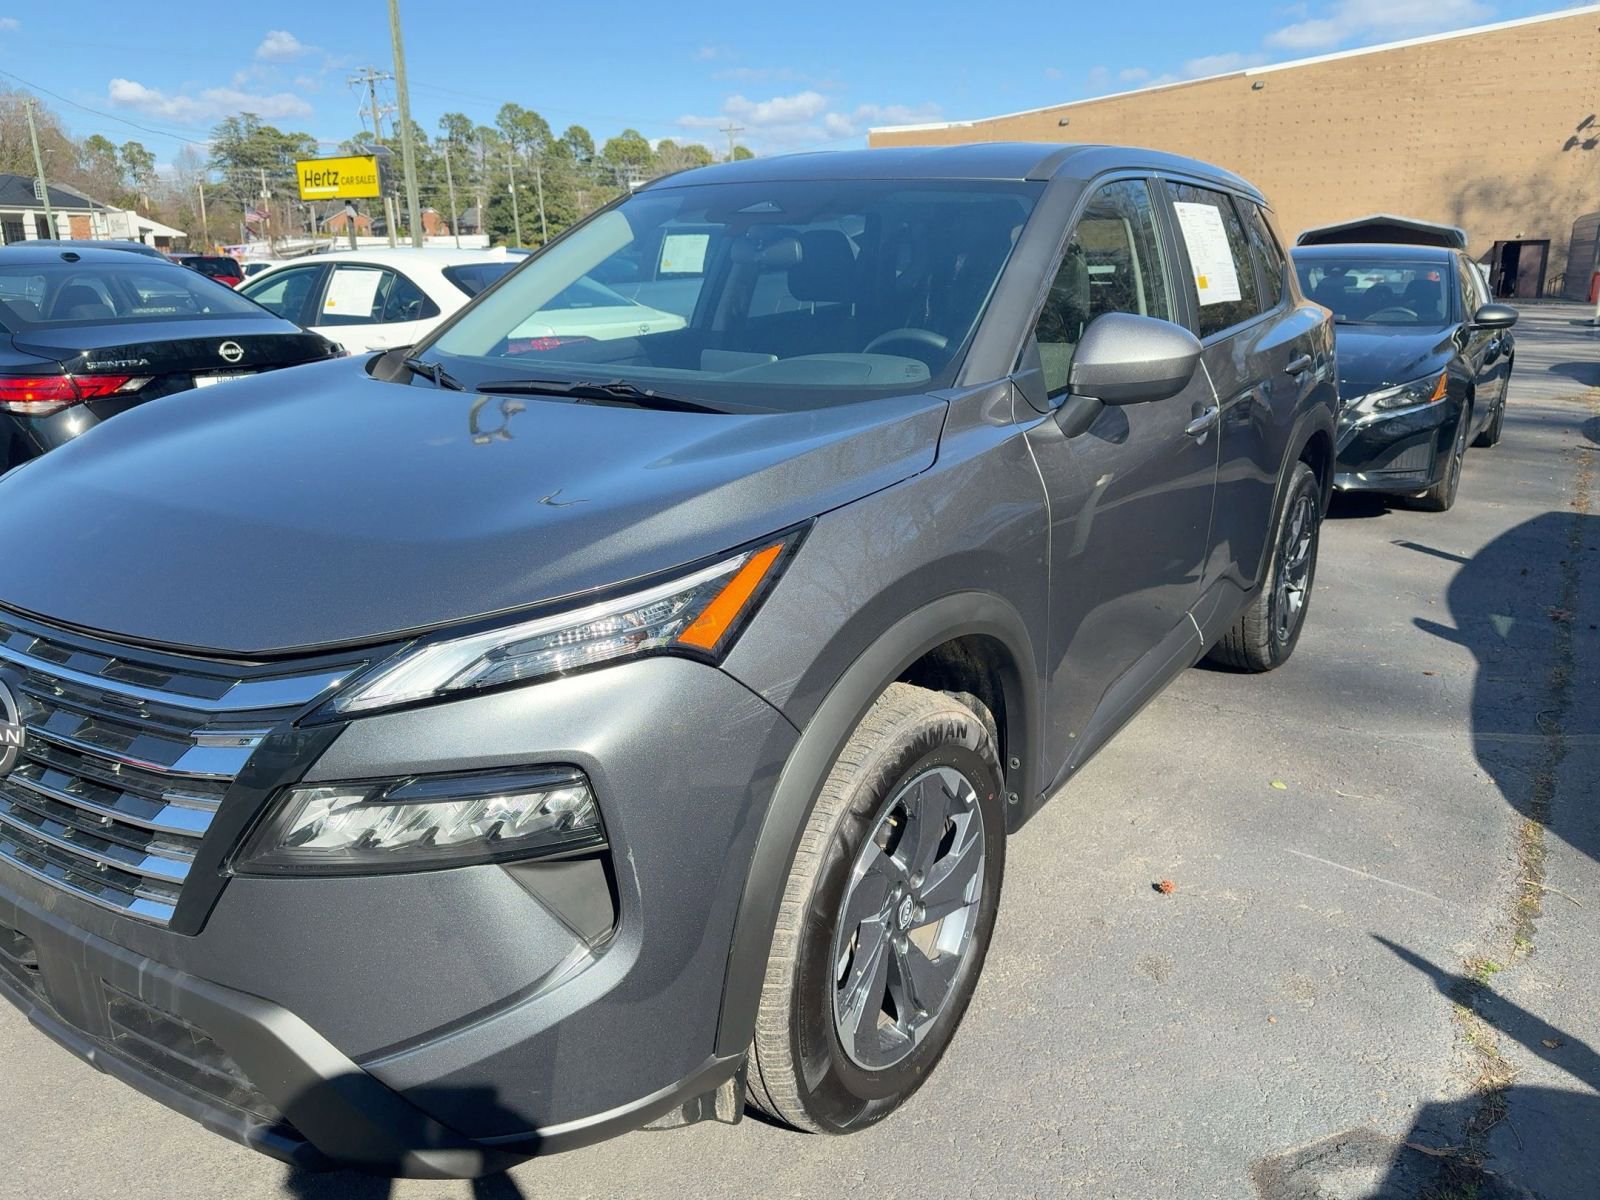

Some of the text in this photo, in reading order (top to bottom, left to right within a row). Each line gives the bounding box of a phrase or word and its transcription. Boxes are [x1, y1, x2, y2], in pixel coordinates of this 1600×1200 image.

[304, 169, 376, 188] Hertz CAR SALES
[86, 358, 151, 370] SENTRA
